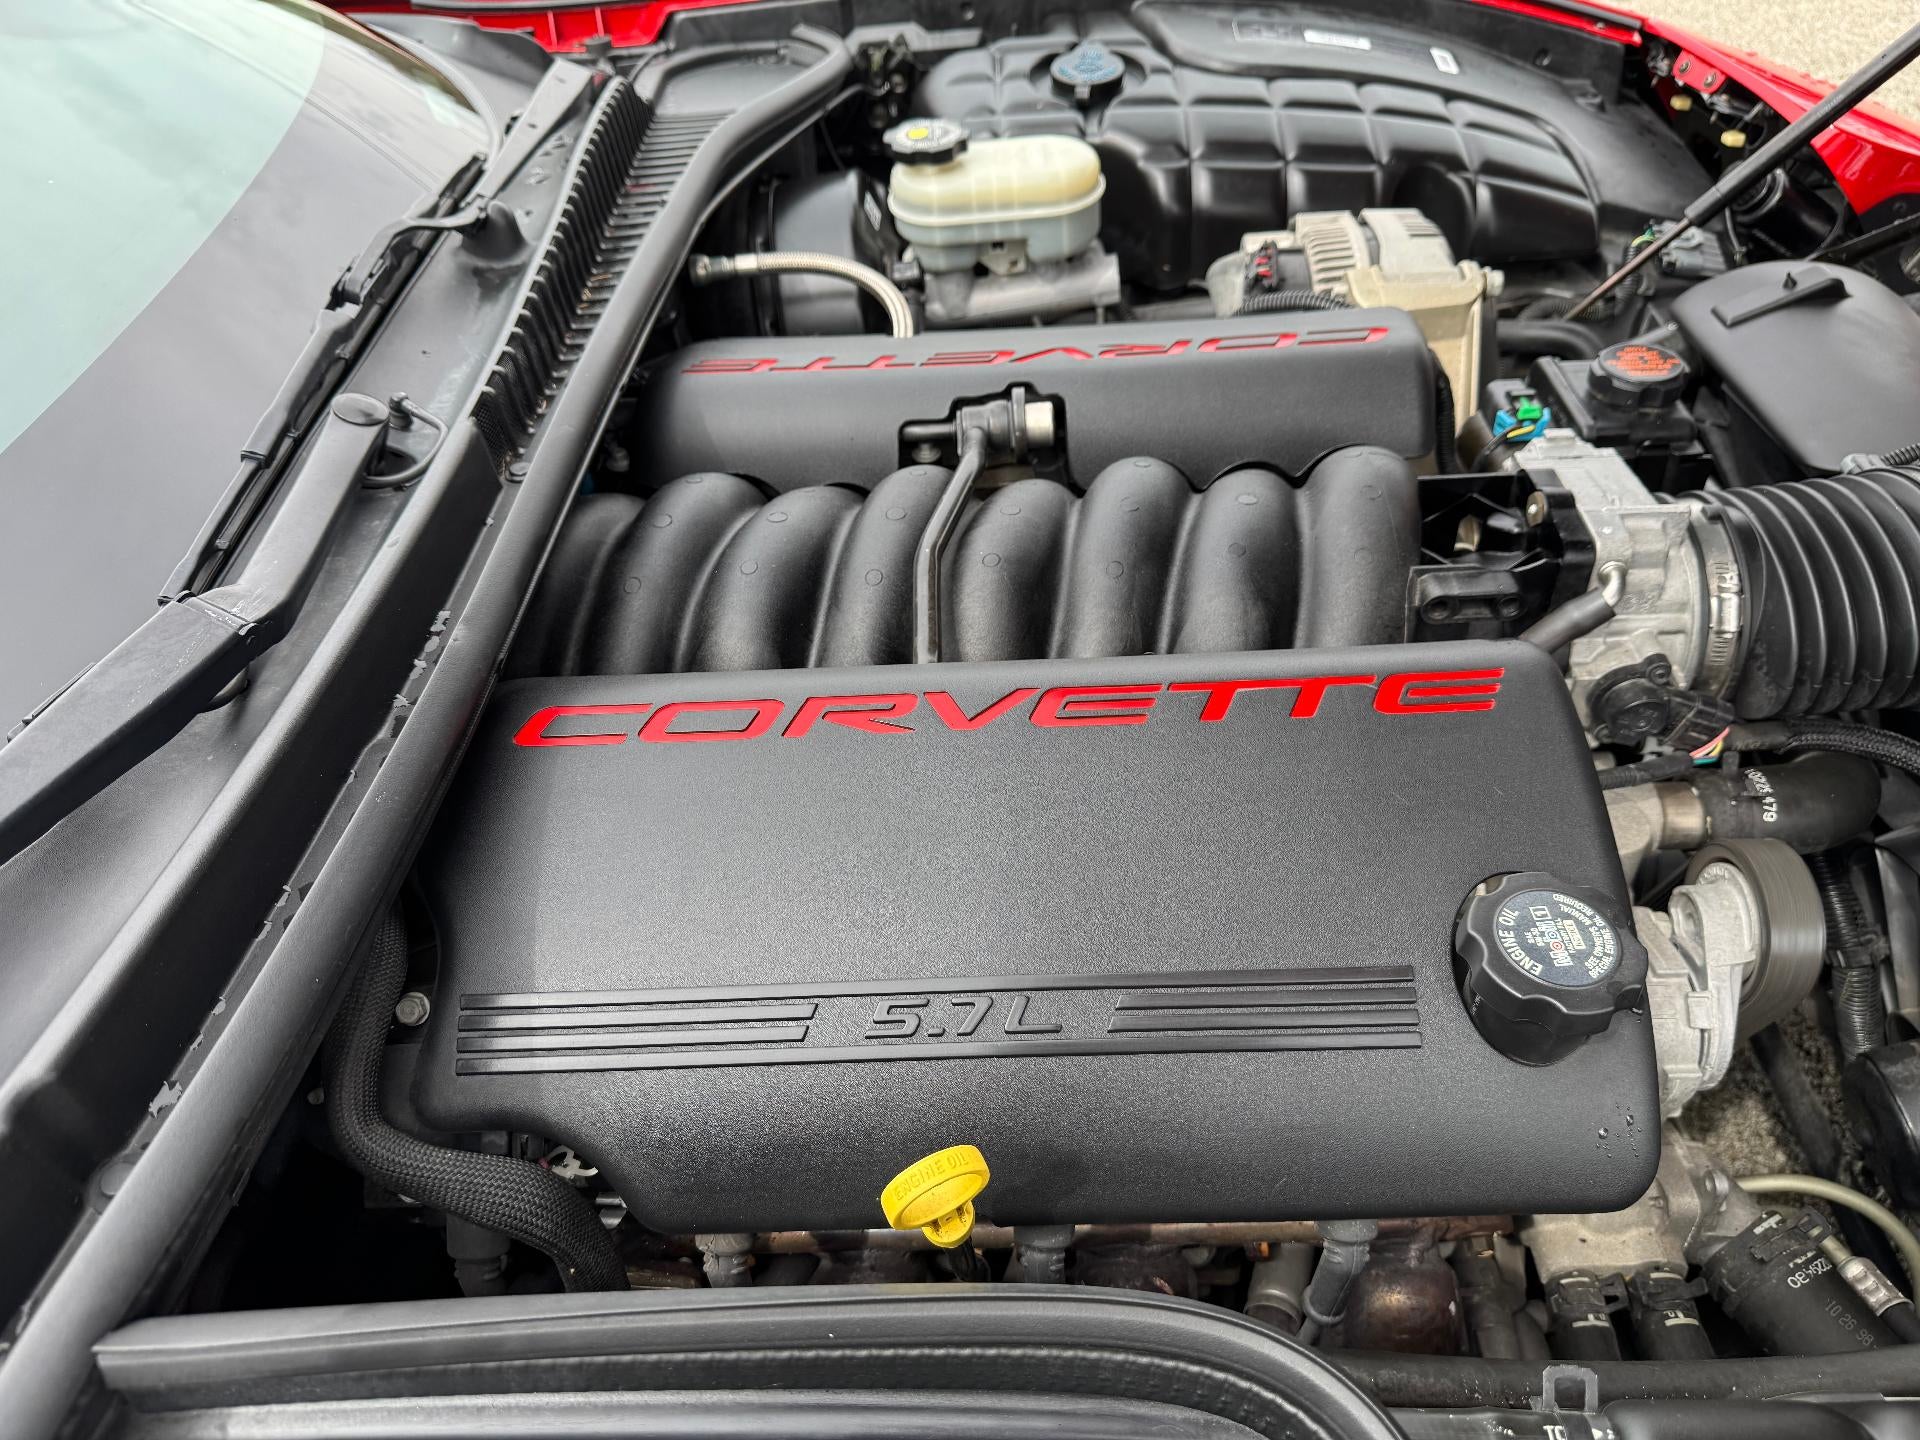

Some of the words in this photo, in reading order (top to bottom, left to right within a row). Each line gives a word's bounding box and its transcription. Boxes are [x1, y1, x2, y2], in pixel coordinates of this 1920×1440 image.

[682, 326, 1390, 374] CORVETTE
[512, 668, 1505, 748] CORVETTE
[1498, 907, 1521, 927] OIL
[1552, 892, 1592, 915] REQUIRED
[1557, 903, 1592, 926] MANUAL
[1593, 913, 1605, 927] OIL
[1499, 929, 1545, 976] ENGINE
[864, 994, 1063, 1040] 5.7L
[893, 1159, 946, 1200] ENGINE
[945, 1151, 969, 1169] OIL
